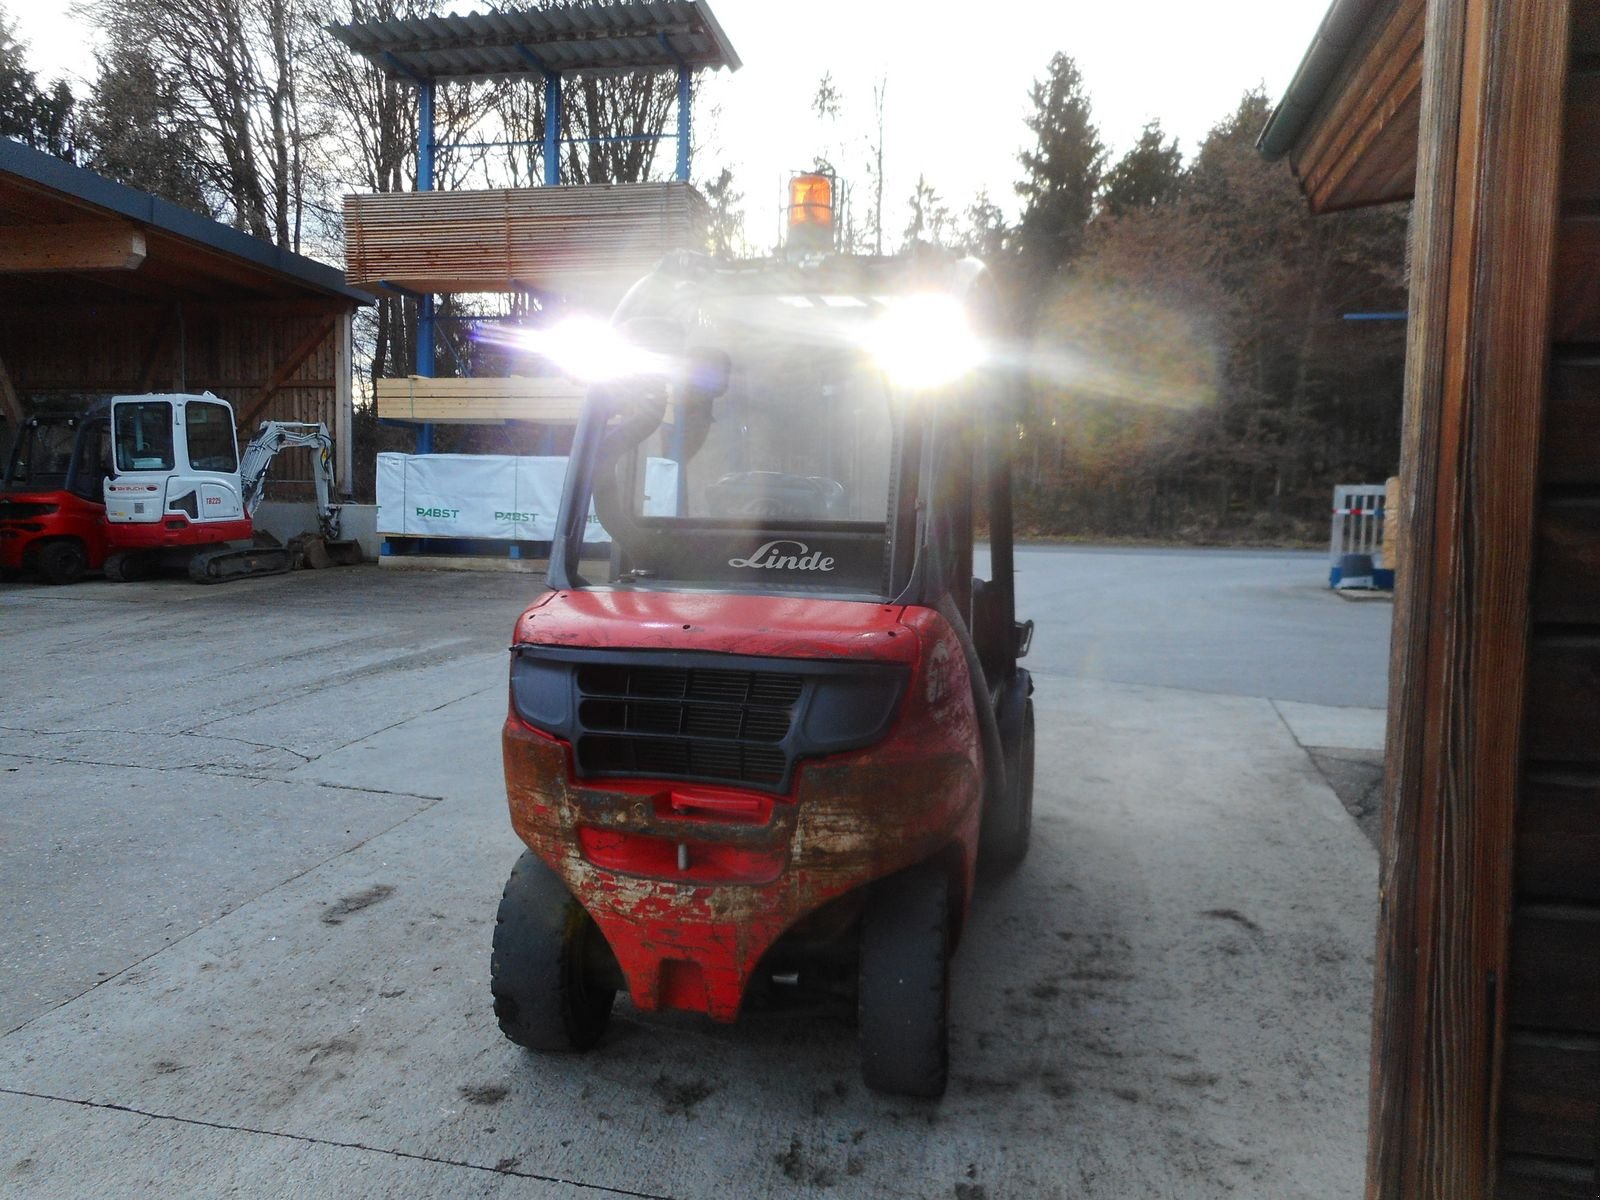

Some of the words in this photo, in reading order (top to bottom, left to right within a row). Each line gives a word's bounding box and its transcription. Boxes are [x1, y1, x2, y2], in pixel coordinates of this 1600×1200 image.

[416, 507, 460, 519] PABST
[495, 511, 539, 523] PABST
[728, 540, 835, 571] Linde
